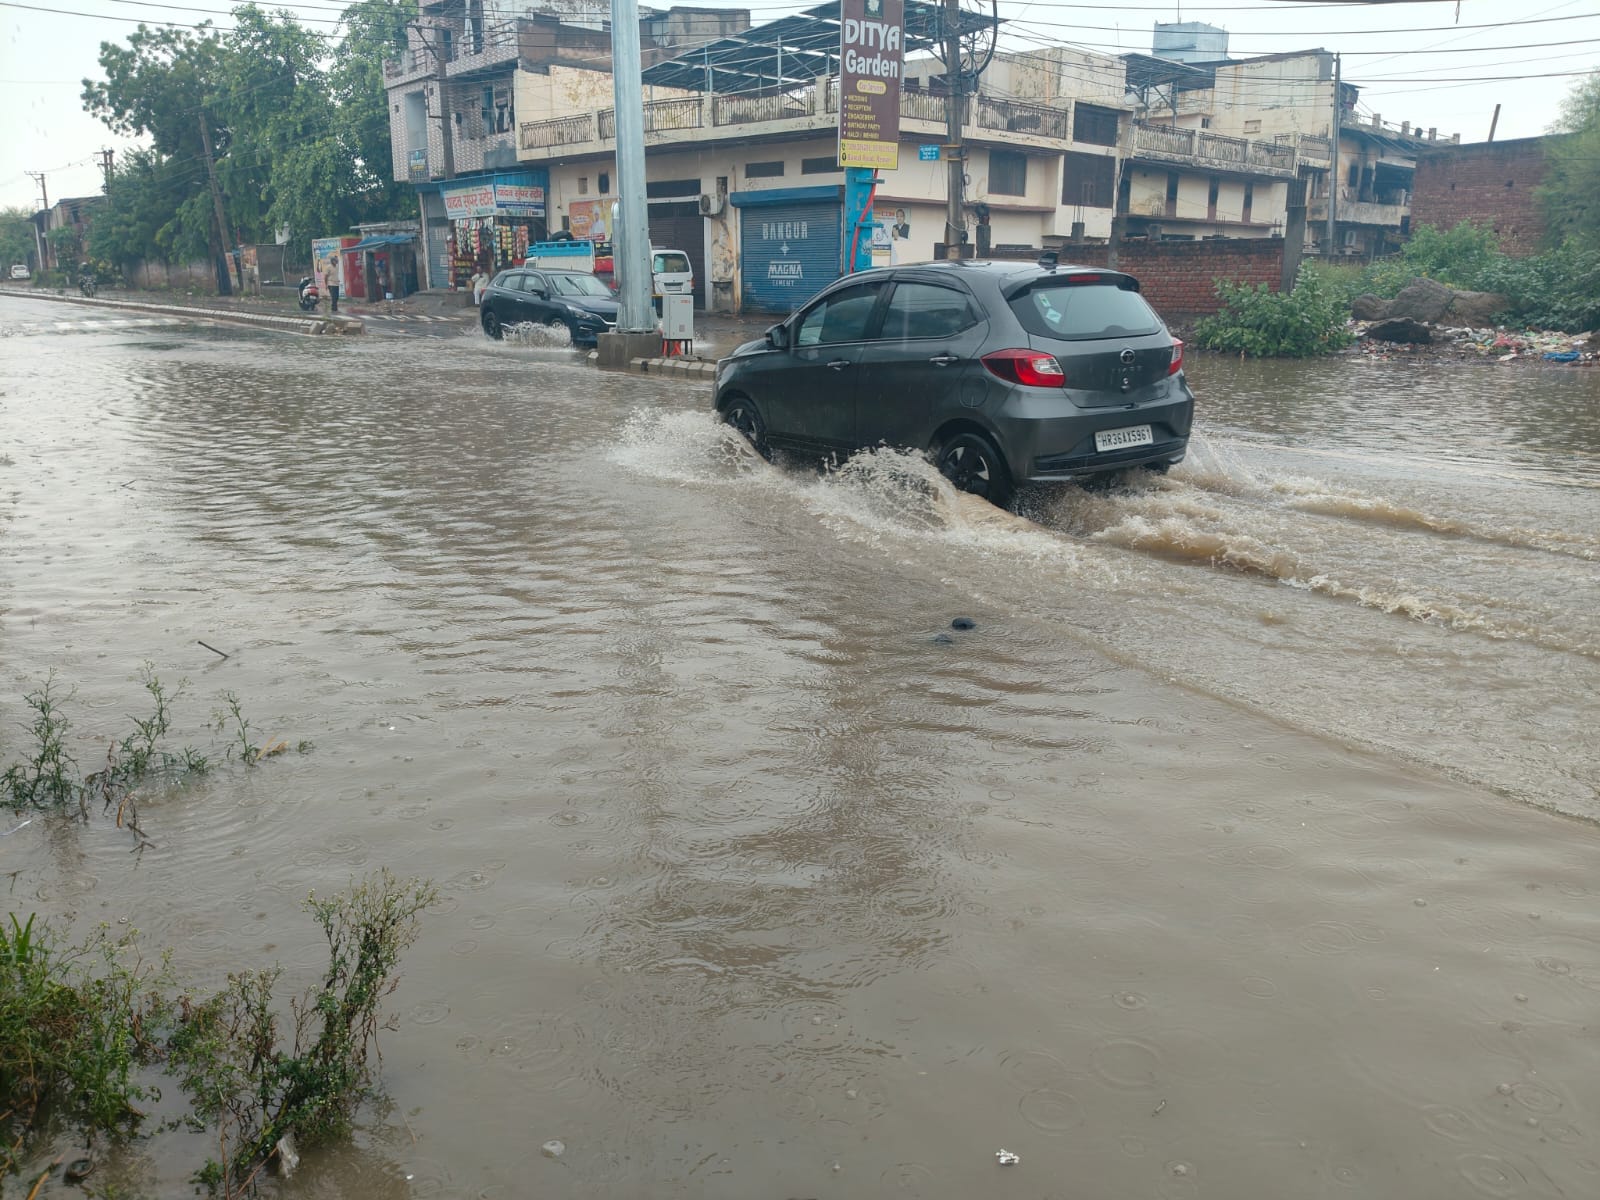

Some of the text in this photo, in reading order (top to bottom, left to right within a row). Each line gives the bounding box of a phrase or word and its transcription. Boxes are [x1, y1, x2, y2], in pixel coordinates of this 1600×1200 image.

[845, 18, 900, 52] DITYA
[845, 49, 898, 78] Garden
[762, 221, 808, 240] BANGUR
[768, 264, 803, 279] MAGNA
